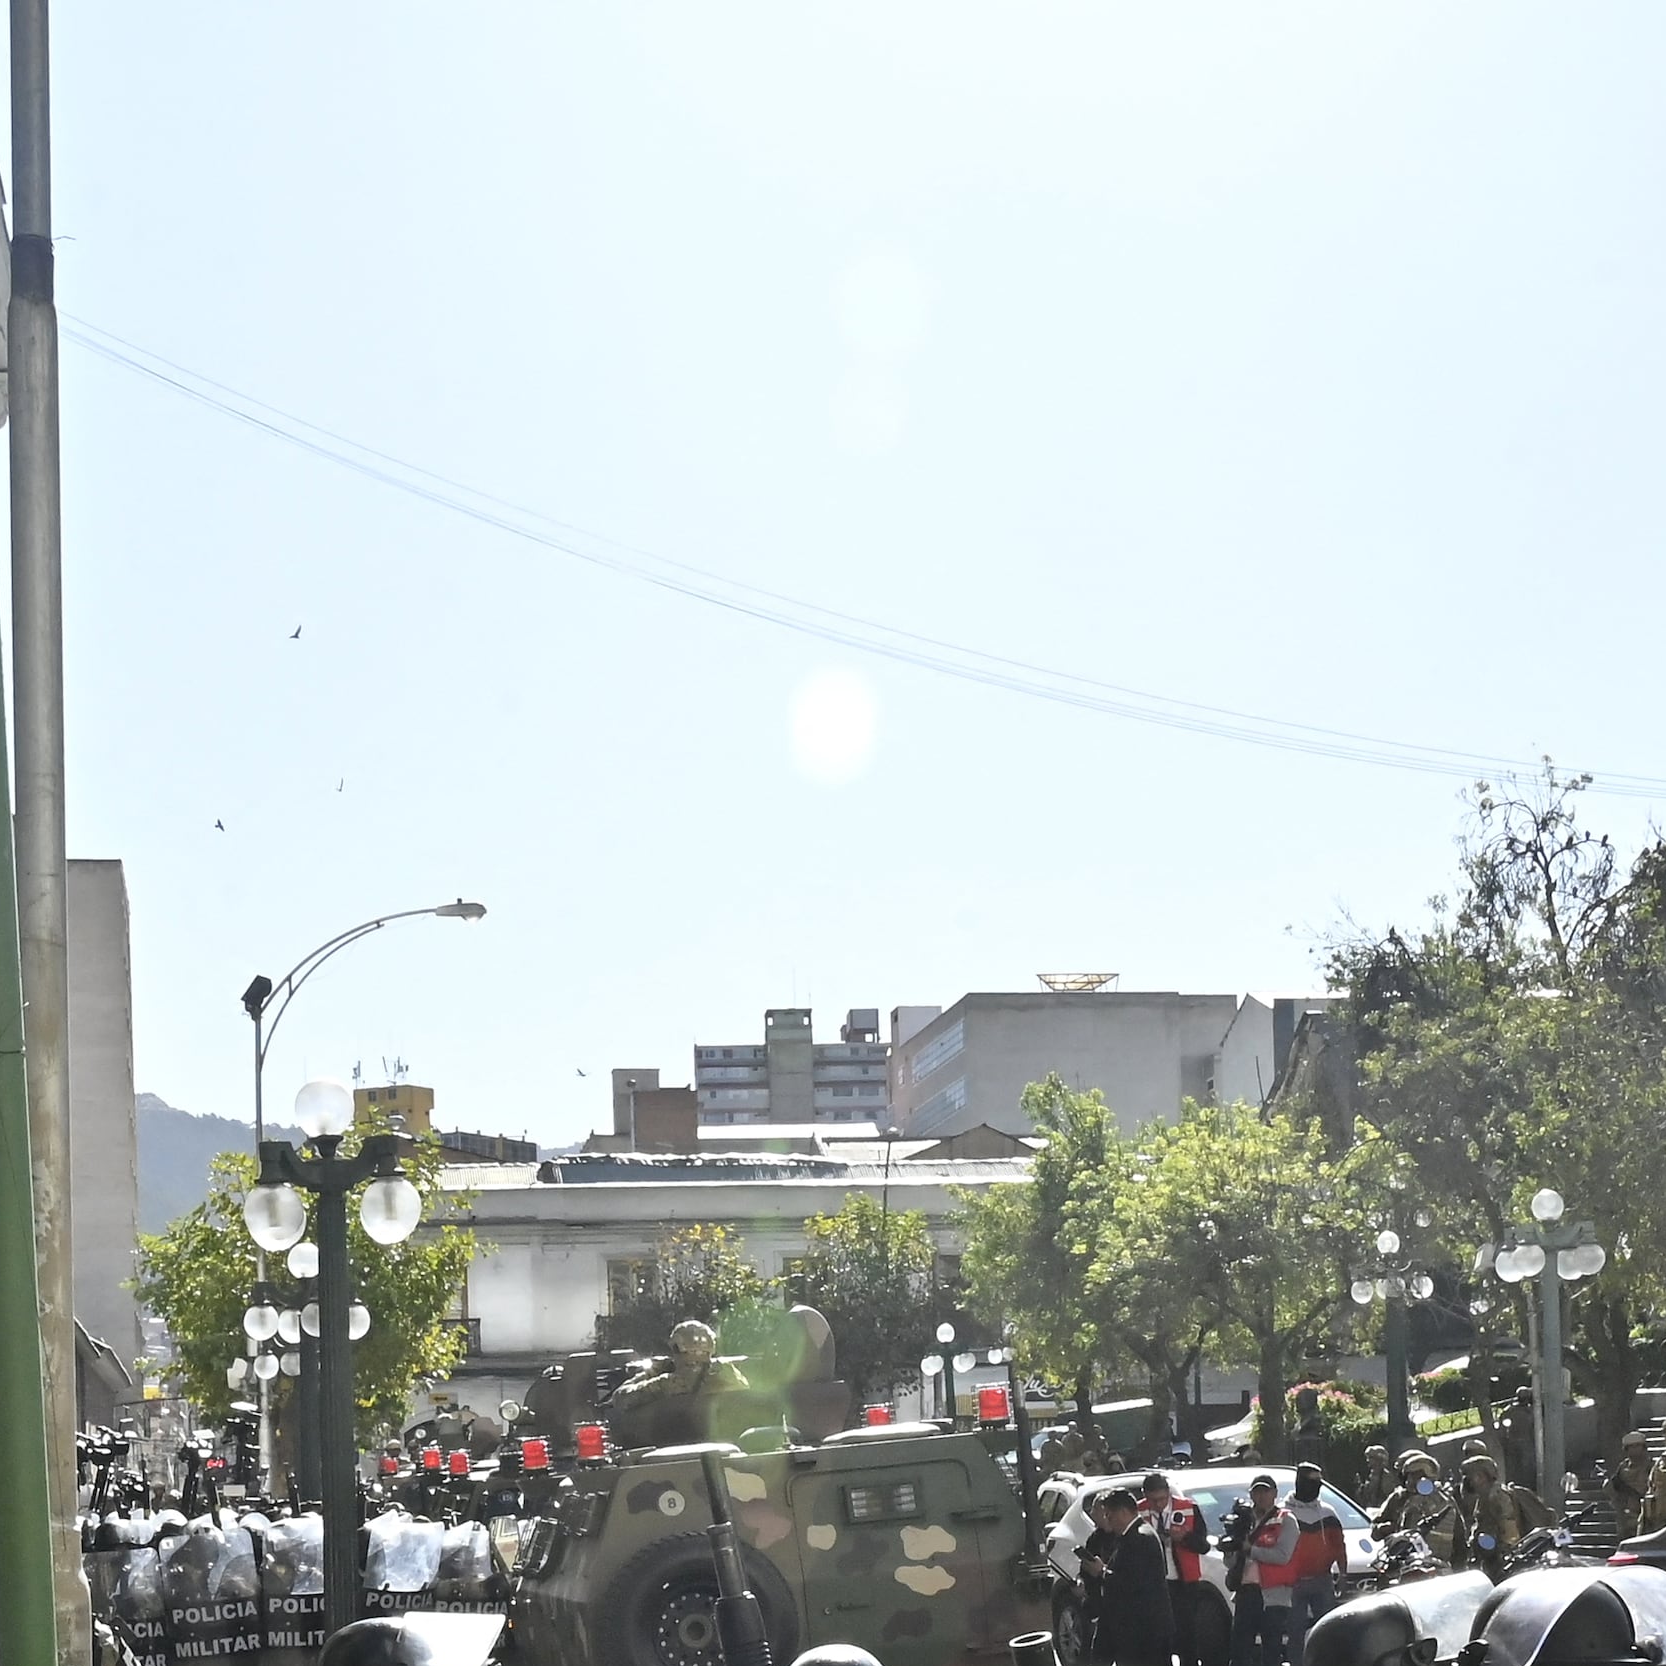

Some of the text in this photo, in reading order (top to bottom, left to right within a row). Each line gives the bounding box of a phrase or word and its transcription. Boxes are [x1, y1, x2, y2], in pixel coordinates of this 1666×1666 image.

[269, 1598, 325, 1614] POLI
[365, 1592, 433, 1609] POLICIA
[172, 1600, 258, 1624] POLICIA
[176, 1633, 261, 1659] MILITAR
[268, 1630, 326, 1647] MILIT
